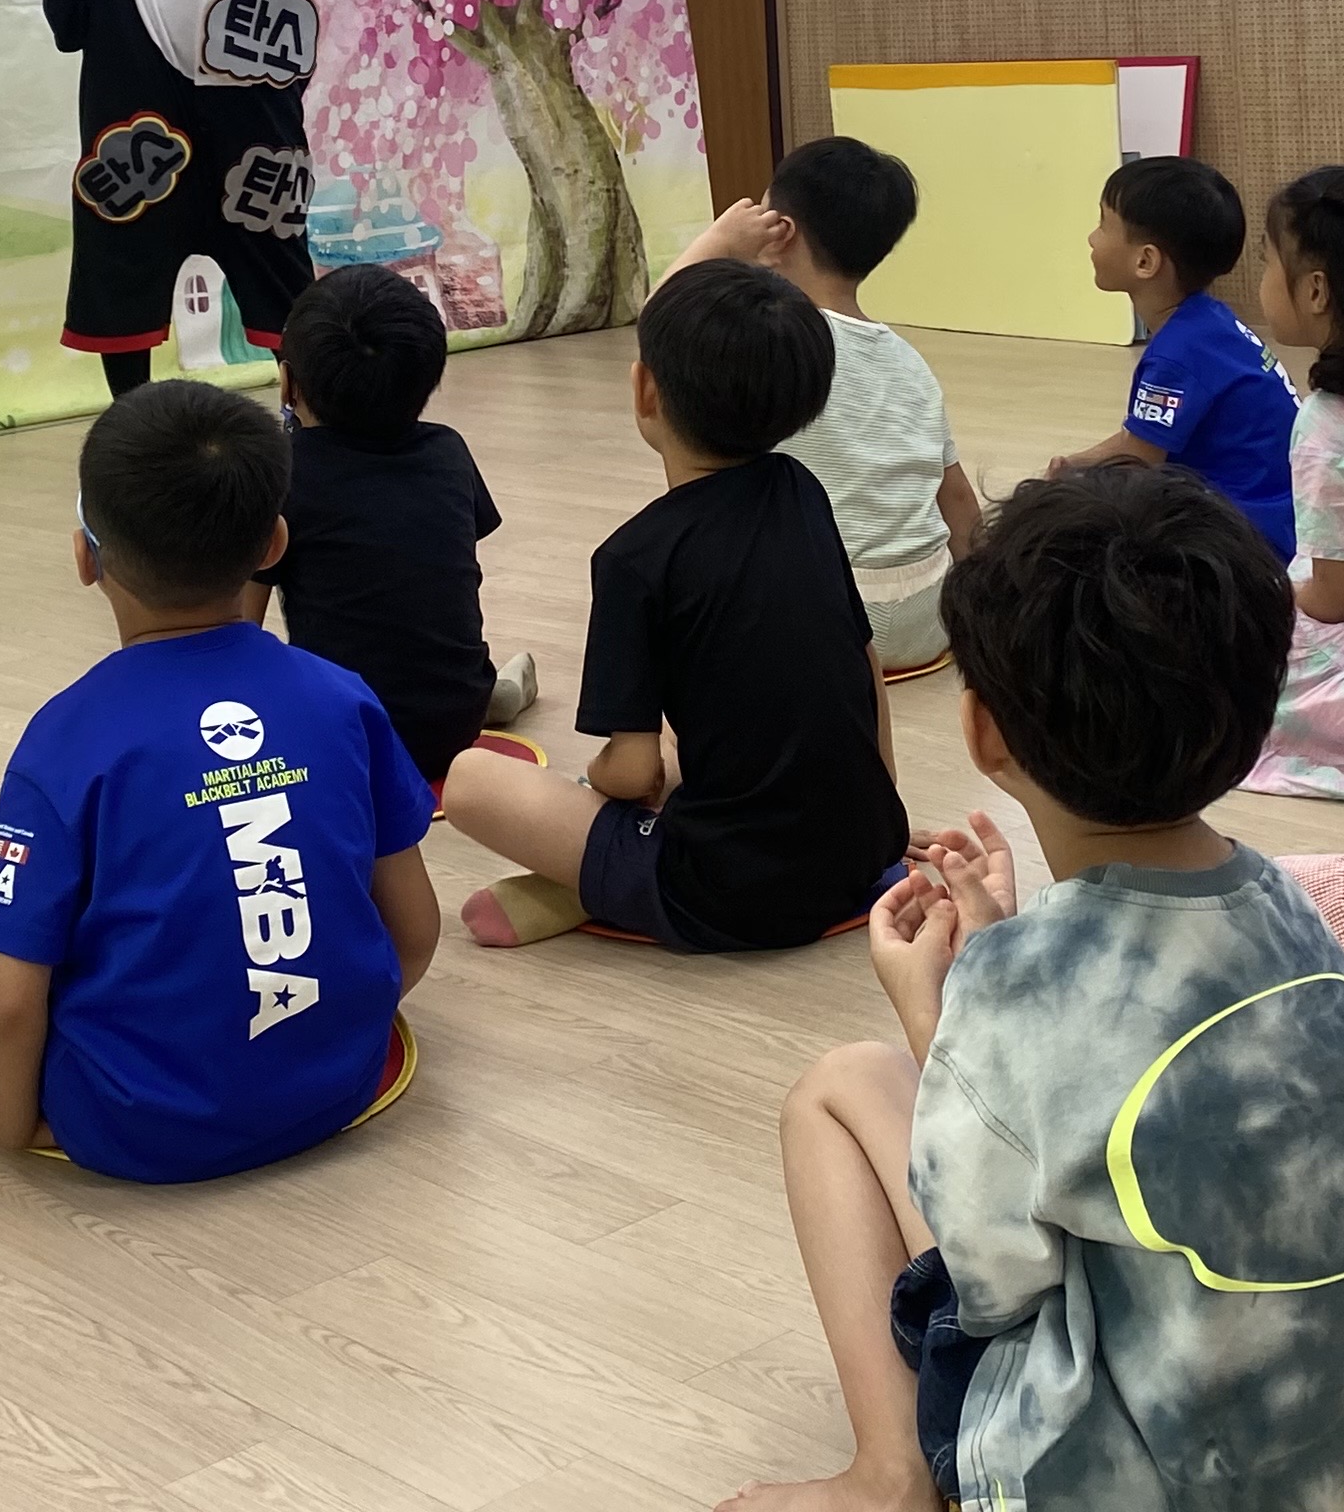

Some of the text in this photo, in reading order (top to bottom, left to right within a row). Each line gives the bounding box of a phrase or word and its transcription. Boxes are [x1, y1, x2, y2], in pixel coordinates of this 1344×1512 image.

[80, 130, 186, 217] 탄소
[235, 154, 309, 224] 탄소
[184, 767, 309, 808] BLACKBELT ACADEMY
[202, 756, 286, 786] MARTIALARTS
[218, 791, 320, 1041] MBA
